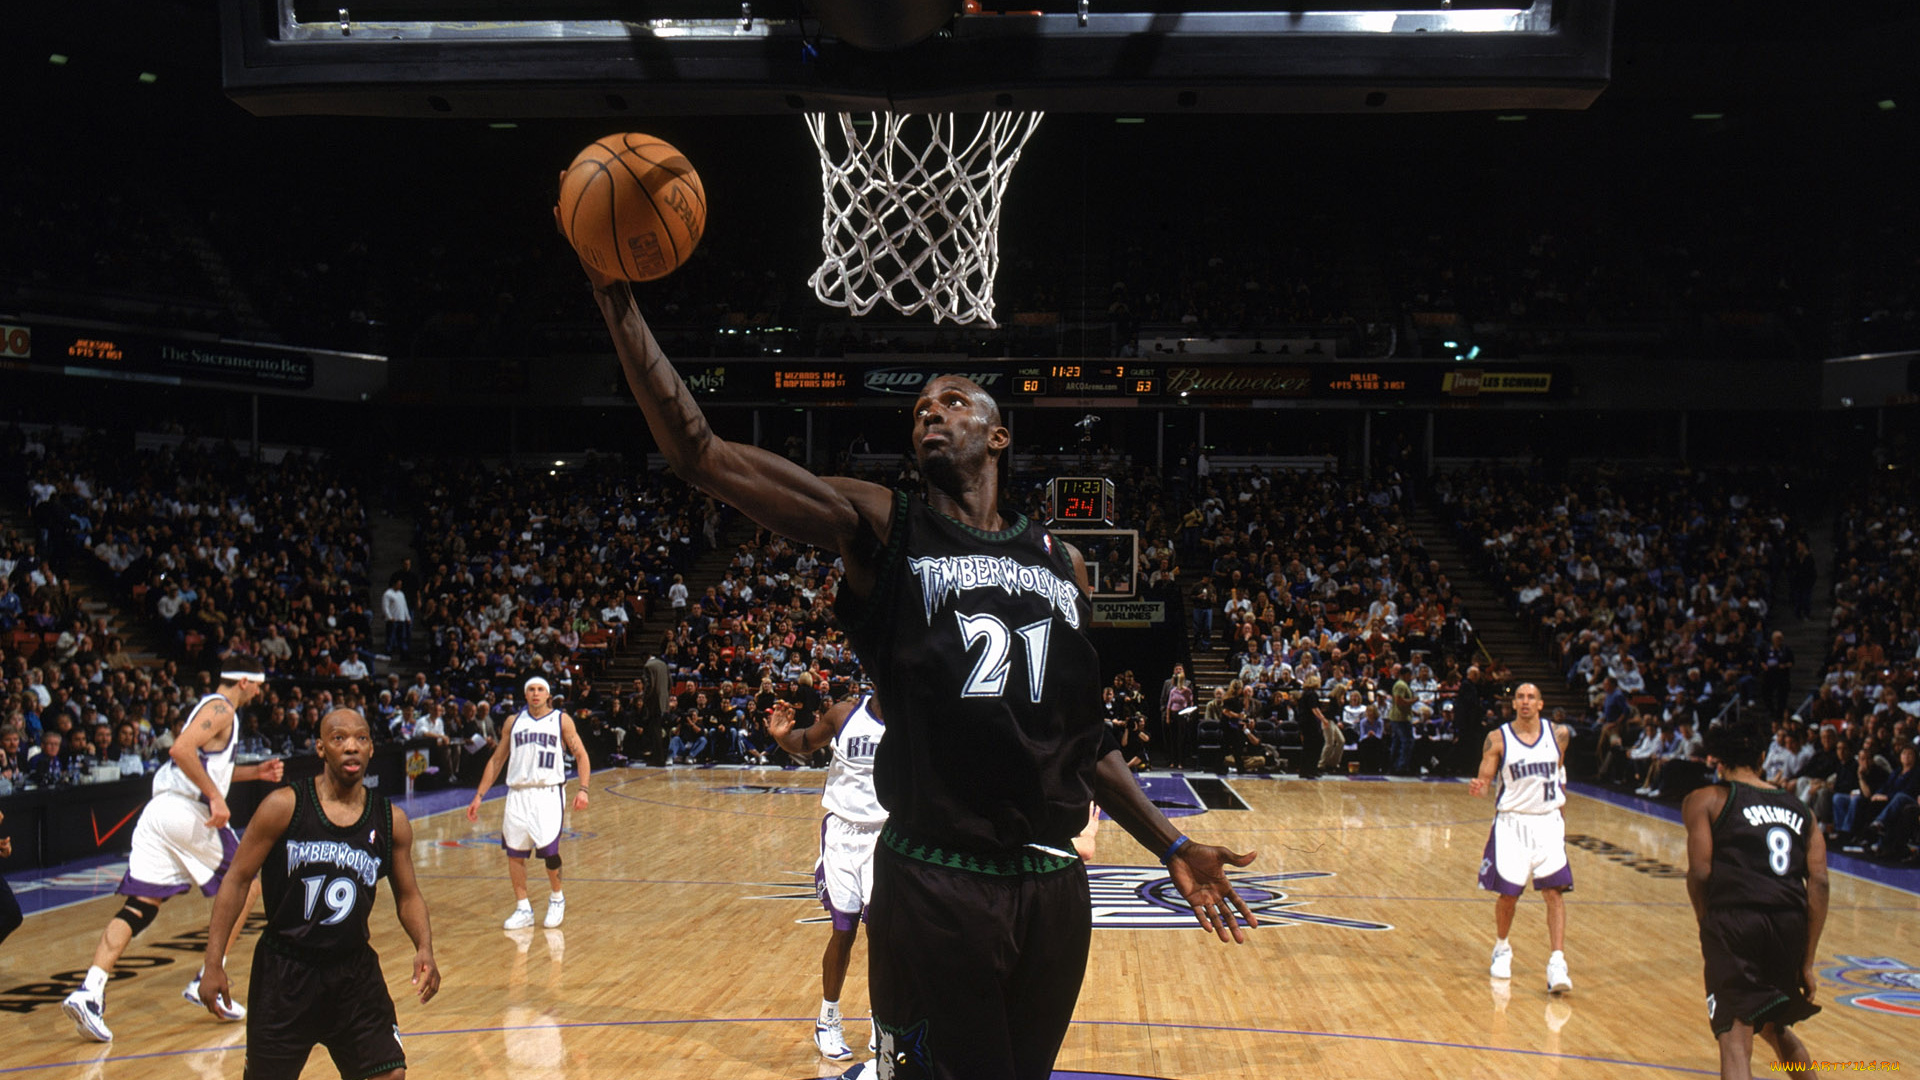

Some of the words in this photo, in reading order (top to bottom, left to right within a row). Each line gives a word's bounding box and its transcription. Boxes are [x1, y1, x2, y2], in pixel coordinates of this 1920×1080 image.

[160, 345, 189, 362] The
[190, 348, 280, 371] Sacramento
[280, 357, 308, 374] Bee
[784, 371, 820, 380] WIZARDS
[866, 372, 924, 386] BUD
[1018, 367, 1041, 376] HOME
[1051, 365, 1082, 378] 11:23
[1115, 365, 1125, 379] 3
[1130, 368, 1156, 376] GUEST
[688, 369, 726, 391] Mist
[1023, 380, 1039, 392] 60
[1136, 380, 1152, 392] 63
[1166, 367, 1312, 393] Budweiser
[1483, 377, 1500, 388] LES
[1063, 481, 1101, 494] 11:23
[1065, 497, 1094, 517] 24
[907, 555, 1080, 630] TIMBERWOLVES
[1096, 603, 1160, 613] SOUTHWEST
[1105, 611, 1152, 621] AIRLINES
[954, 610, 1053, 703] 21
[514, 728, 558, 749] Kings
[538, 751, 555, 770] 10
[1543, 781, 1556, 802] 13
[1766, 826, 1793, 876] 8
[286, 839, 382, 887] TIMBERWOLVES
[301, 874, 358, 925] 19
